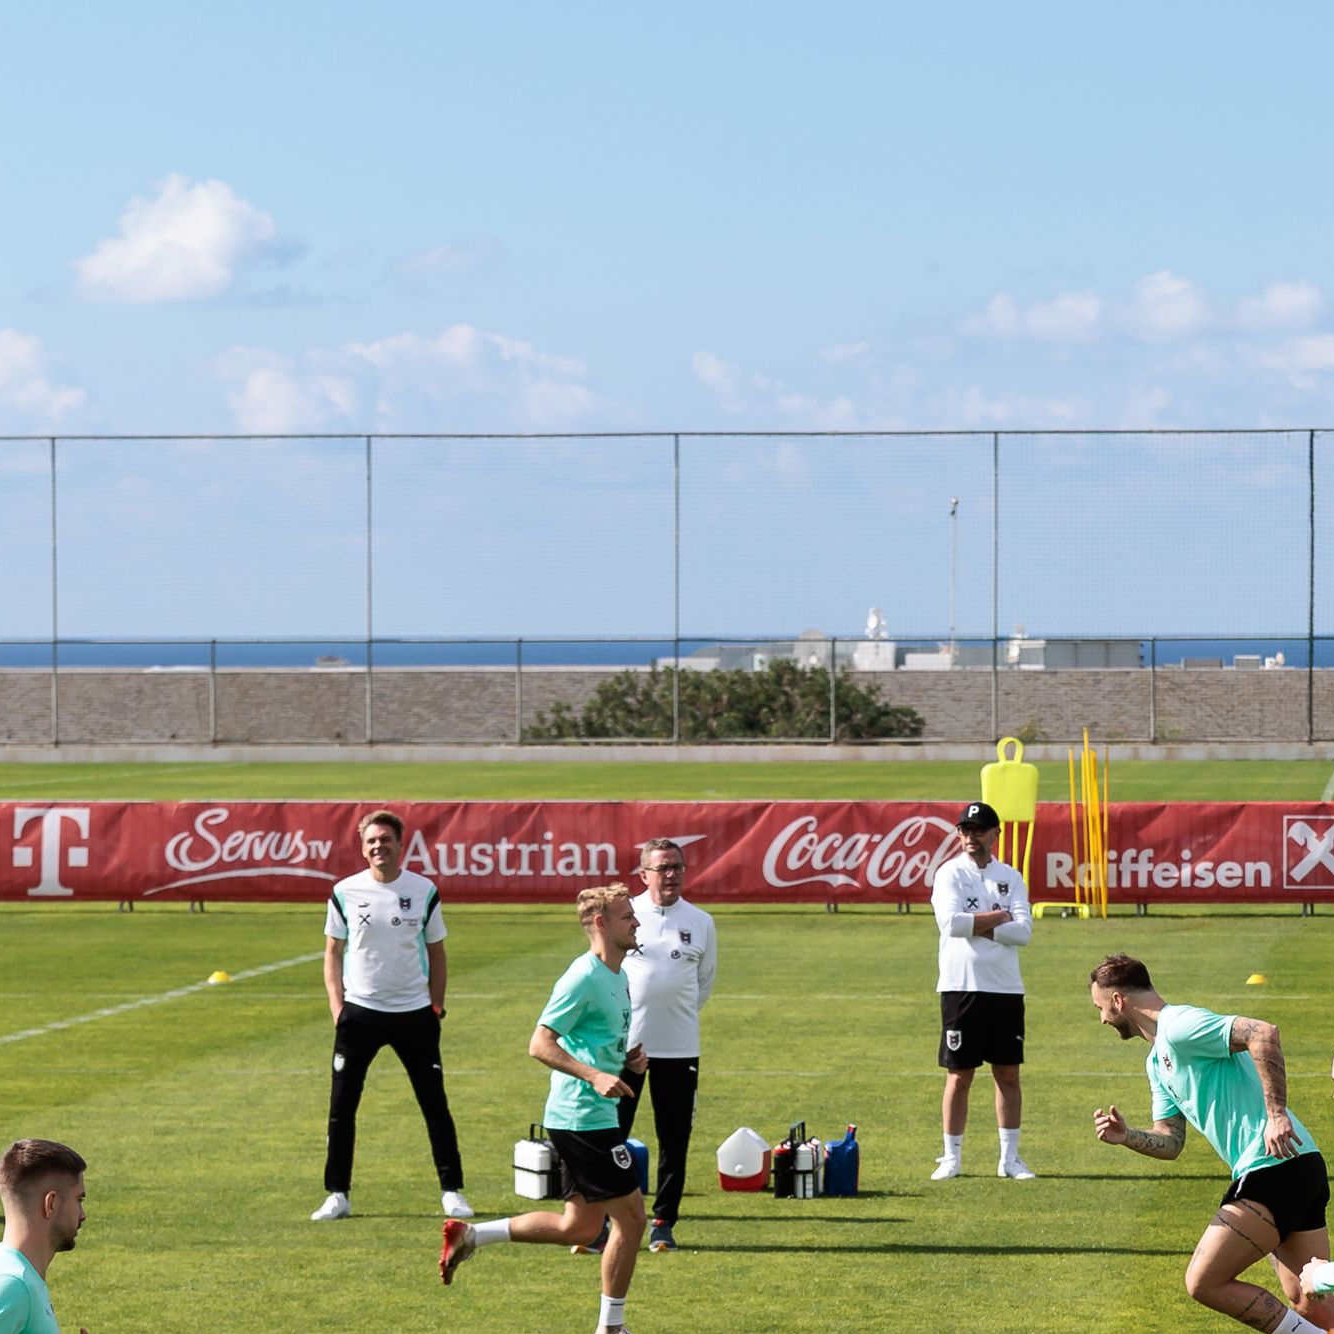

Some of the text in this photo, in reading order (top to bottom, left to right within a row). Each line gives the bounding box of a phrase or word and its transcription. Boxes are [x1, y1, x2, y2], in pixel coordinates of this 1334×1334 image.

[967, 805, 980, 818] P
[401, 830, 619, 876] Austrian
[762, 816, 962, 889] Coca-Col
